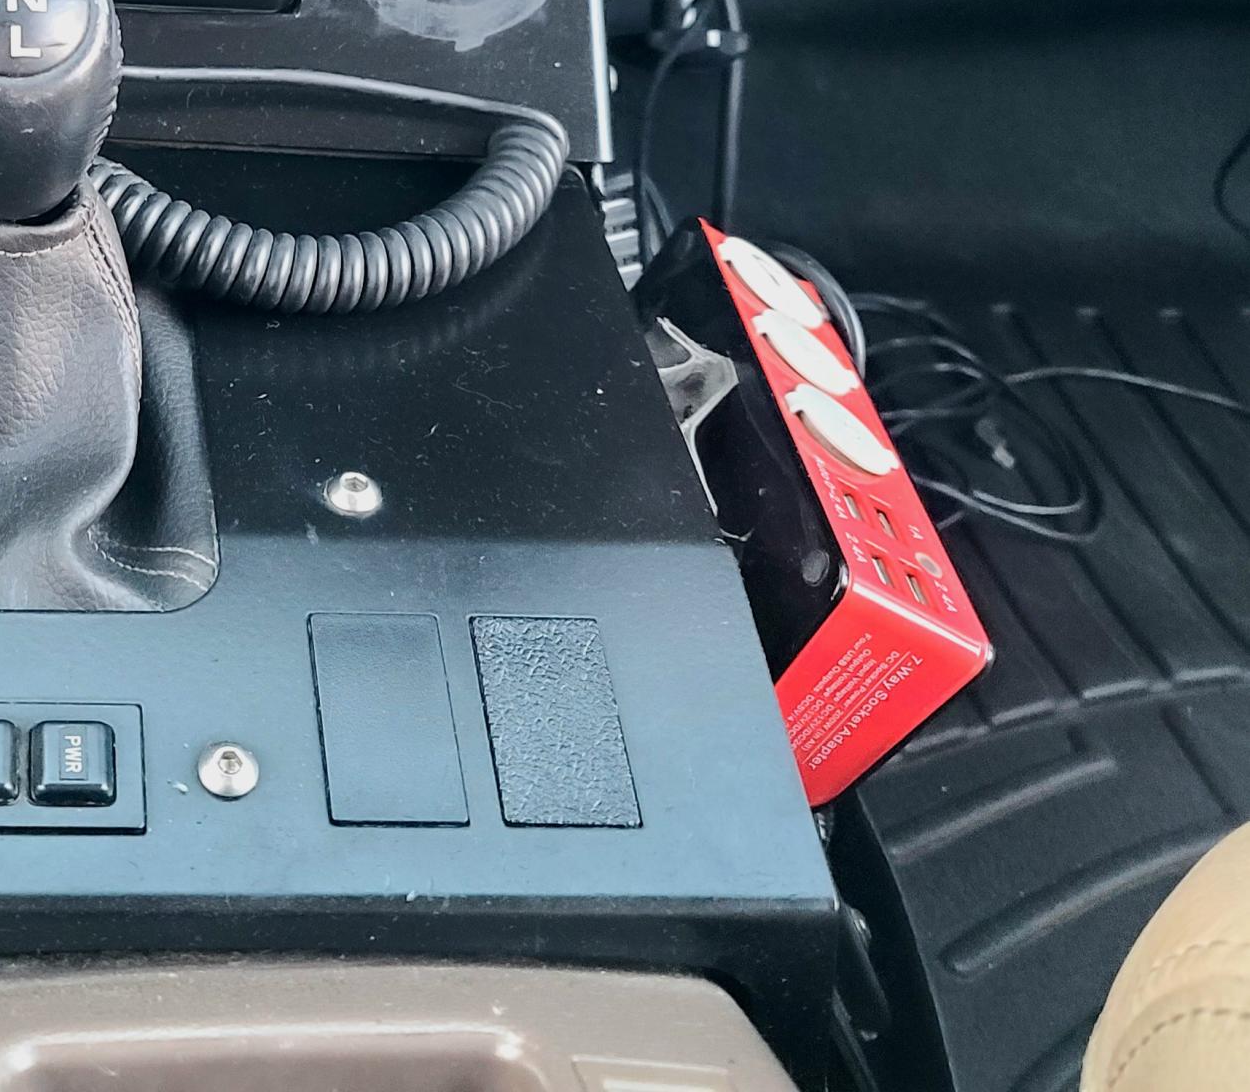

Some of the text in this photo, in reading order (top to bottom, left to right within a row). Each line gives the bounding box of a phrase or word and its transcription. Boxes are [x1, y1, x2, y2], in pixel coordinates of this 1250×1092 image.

[9, 25, 42, 59] L
[808, 654, 924, 770] 7-Way Socket Adapter
[64, 734, 82, 774] PWR
